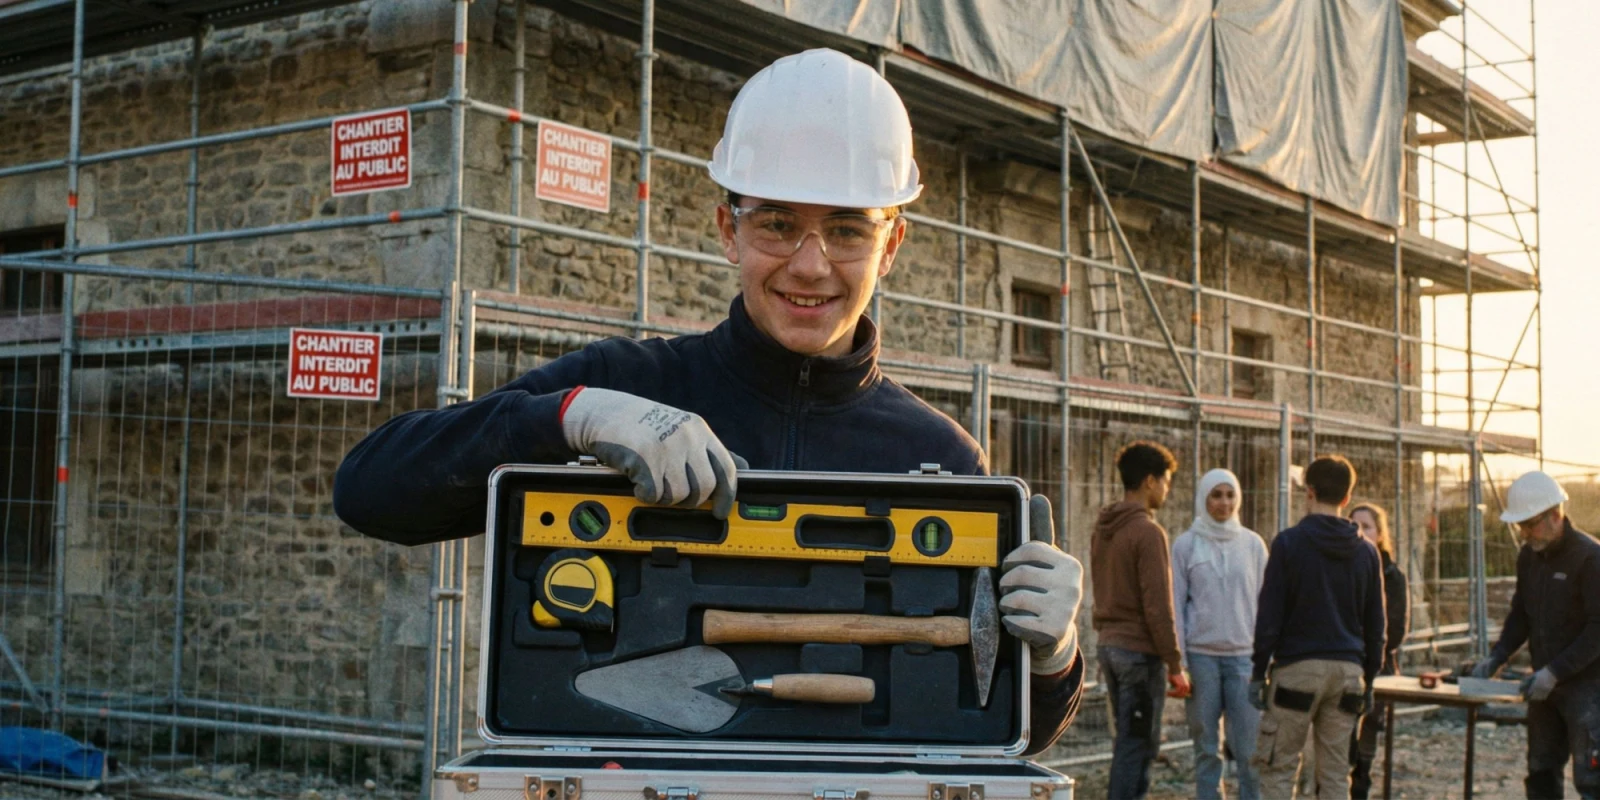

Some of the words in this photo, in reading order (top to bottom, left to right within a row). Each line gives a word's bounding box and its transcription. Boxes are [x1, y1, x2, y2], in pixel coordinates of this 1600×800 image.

[337, 116, 404, 141] CHANTIER
[341, 136, 402, 160] INTERDIT
[544, 128, 606, 158] CHANTIER
[336, 163, 354, 180] AU
[358, 155, 406, 177] PUBLIC
[546, 148, 603, 177] INTERDIT
[541, 168, 560, 186] AU
[562, 172, 606, 196] PUBLIC
[296, 335, 375, 355] CHANTIER
[299, 354, 371, 374] INTERDIT
[293, 374, 316, 391] AU
[319, 375, 376, 394] PUBLIC
